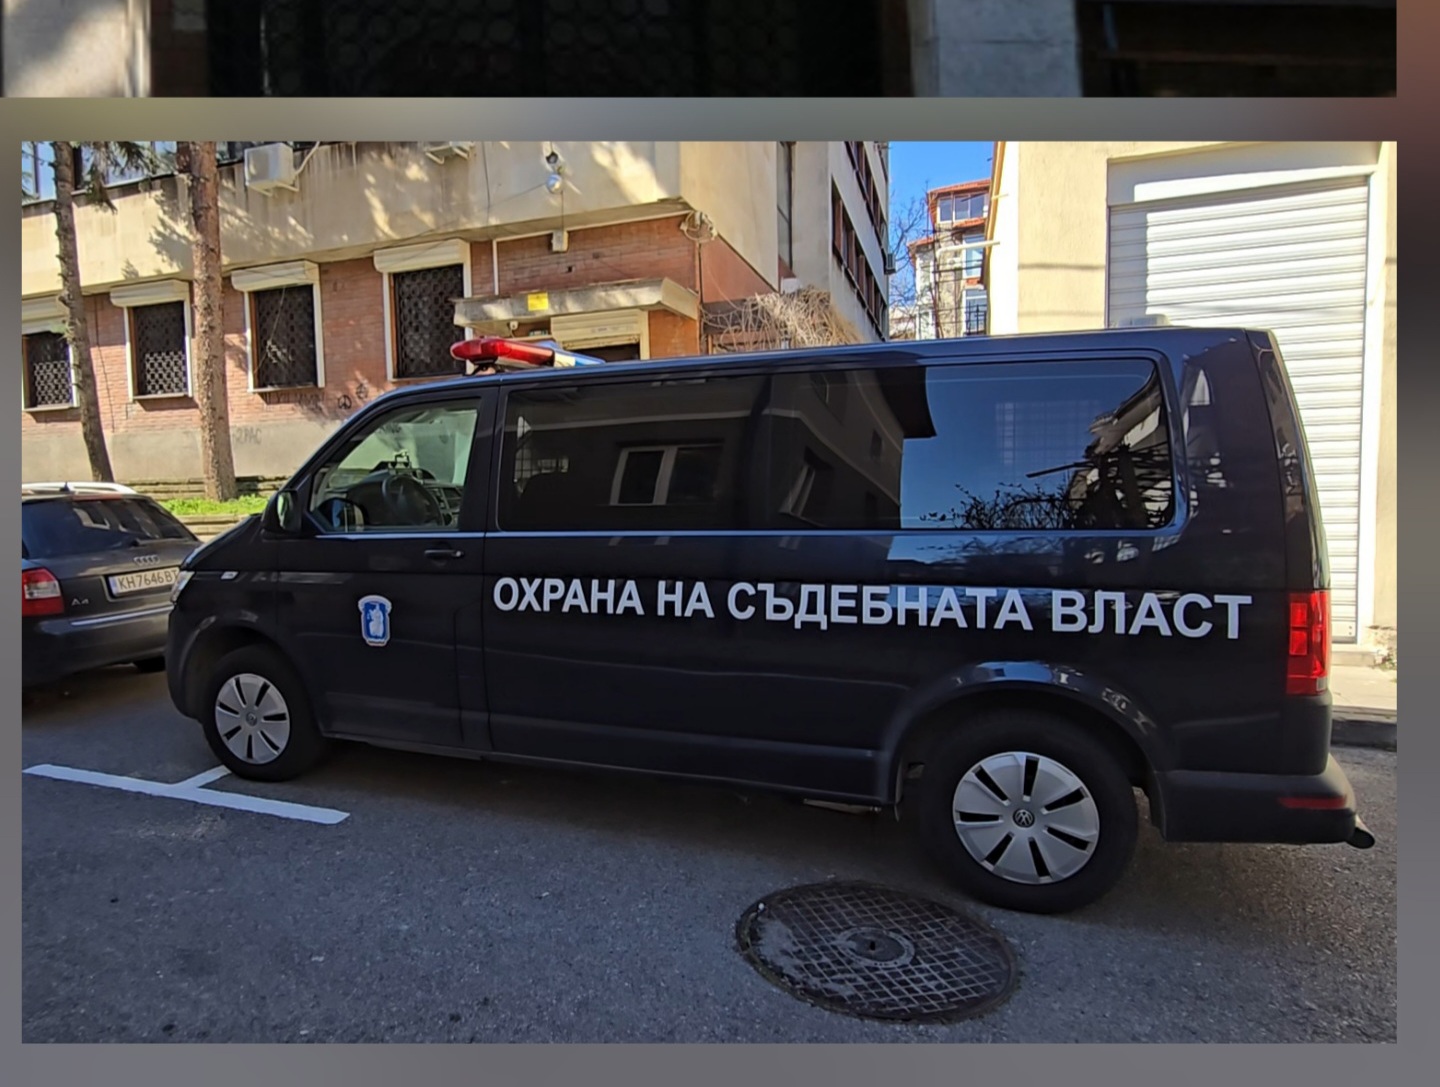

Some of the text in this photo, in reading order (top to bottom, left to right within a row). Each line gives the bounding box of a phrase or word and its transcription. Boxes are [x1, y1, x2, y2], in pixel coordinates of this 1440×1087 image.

[492, 576, 1253, 641] ОХРАНА НА СЪДЕБНАТА ВЛАСТ
